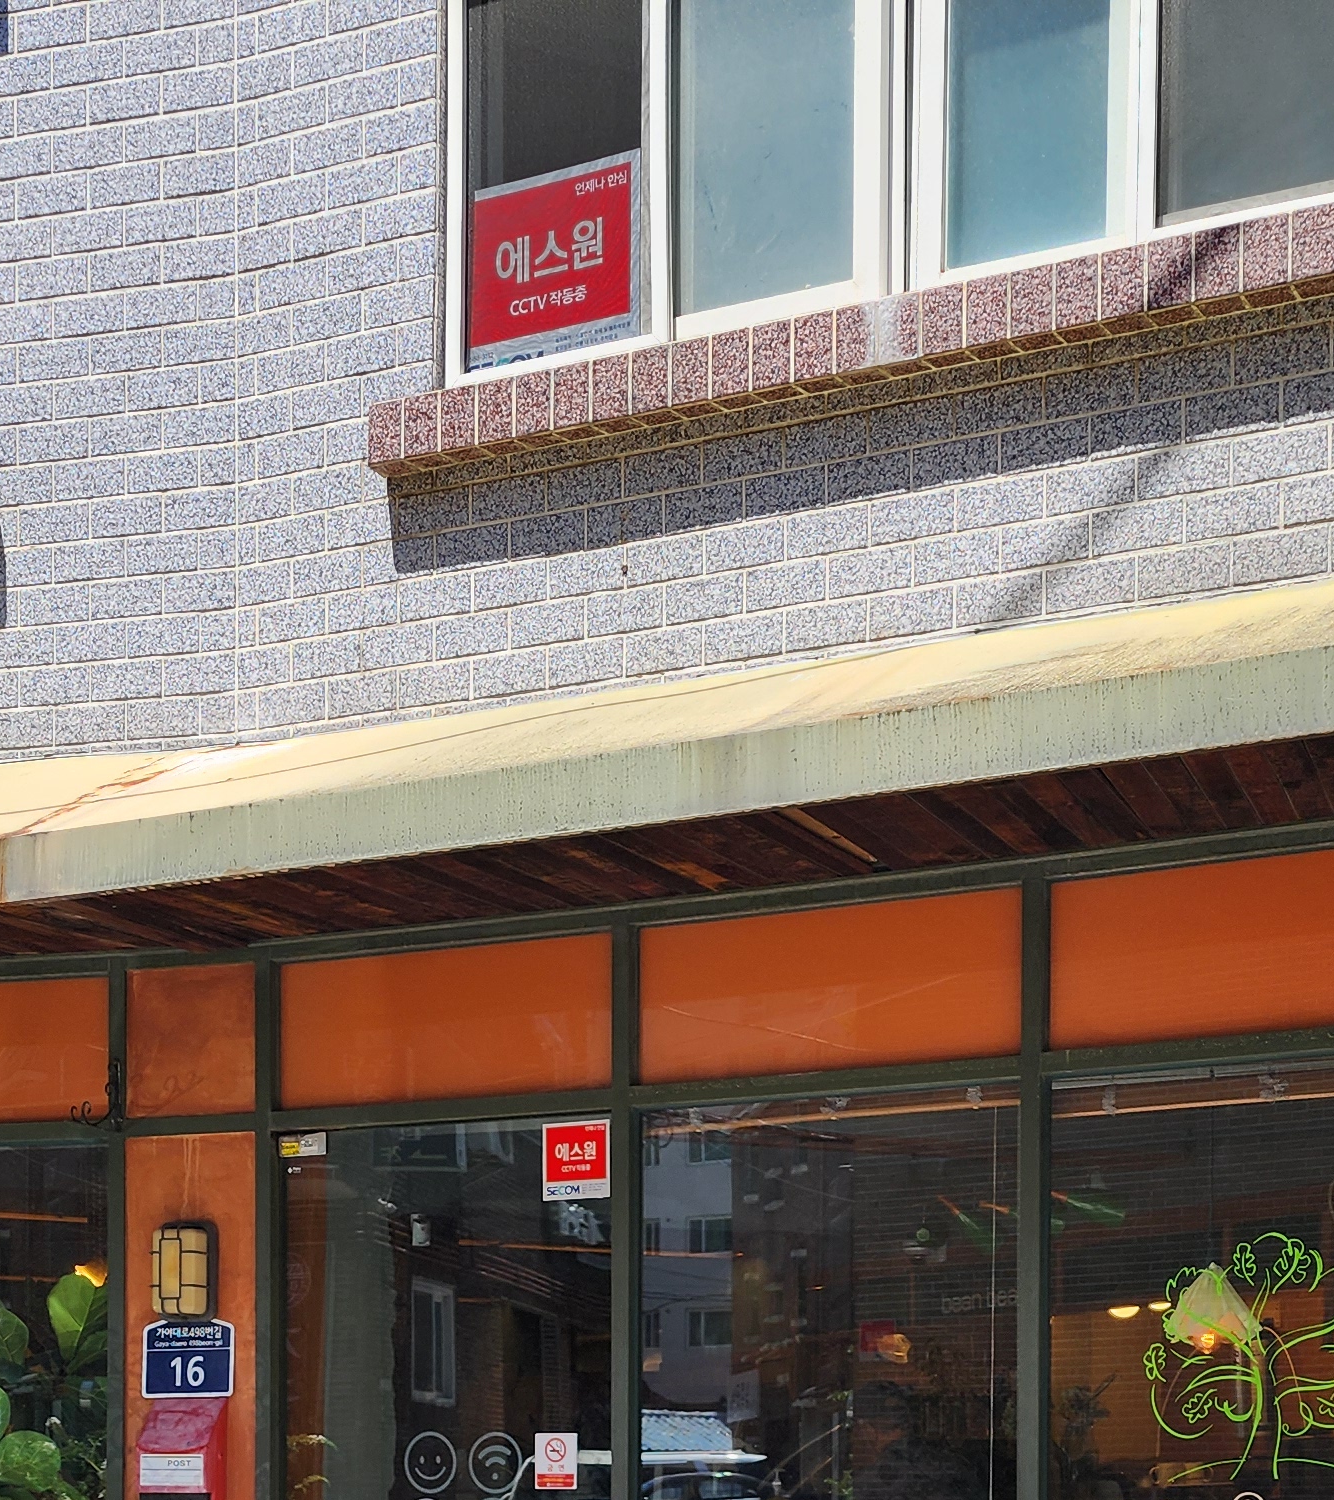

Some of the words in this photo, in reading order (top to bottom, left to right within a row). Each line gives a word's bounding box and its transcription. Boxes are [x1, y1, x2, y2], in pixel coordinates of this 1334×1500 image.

[574, 177, 605, 196] 언제나
[607, 169, 628, 188] 안심
[495, 216, 603, 284] 에스원
[510, 293, 547, 316] CCTV
[549, 284, 588, 307] 작동중
[554, 1140, 597, 1162] 에스원
[546, 1184, 580, 1196] SECOM
[170, 1355, 205, 1387] 16
[167, 1459, 192, 1467] POST
